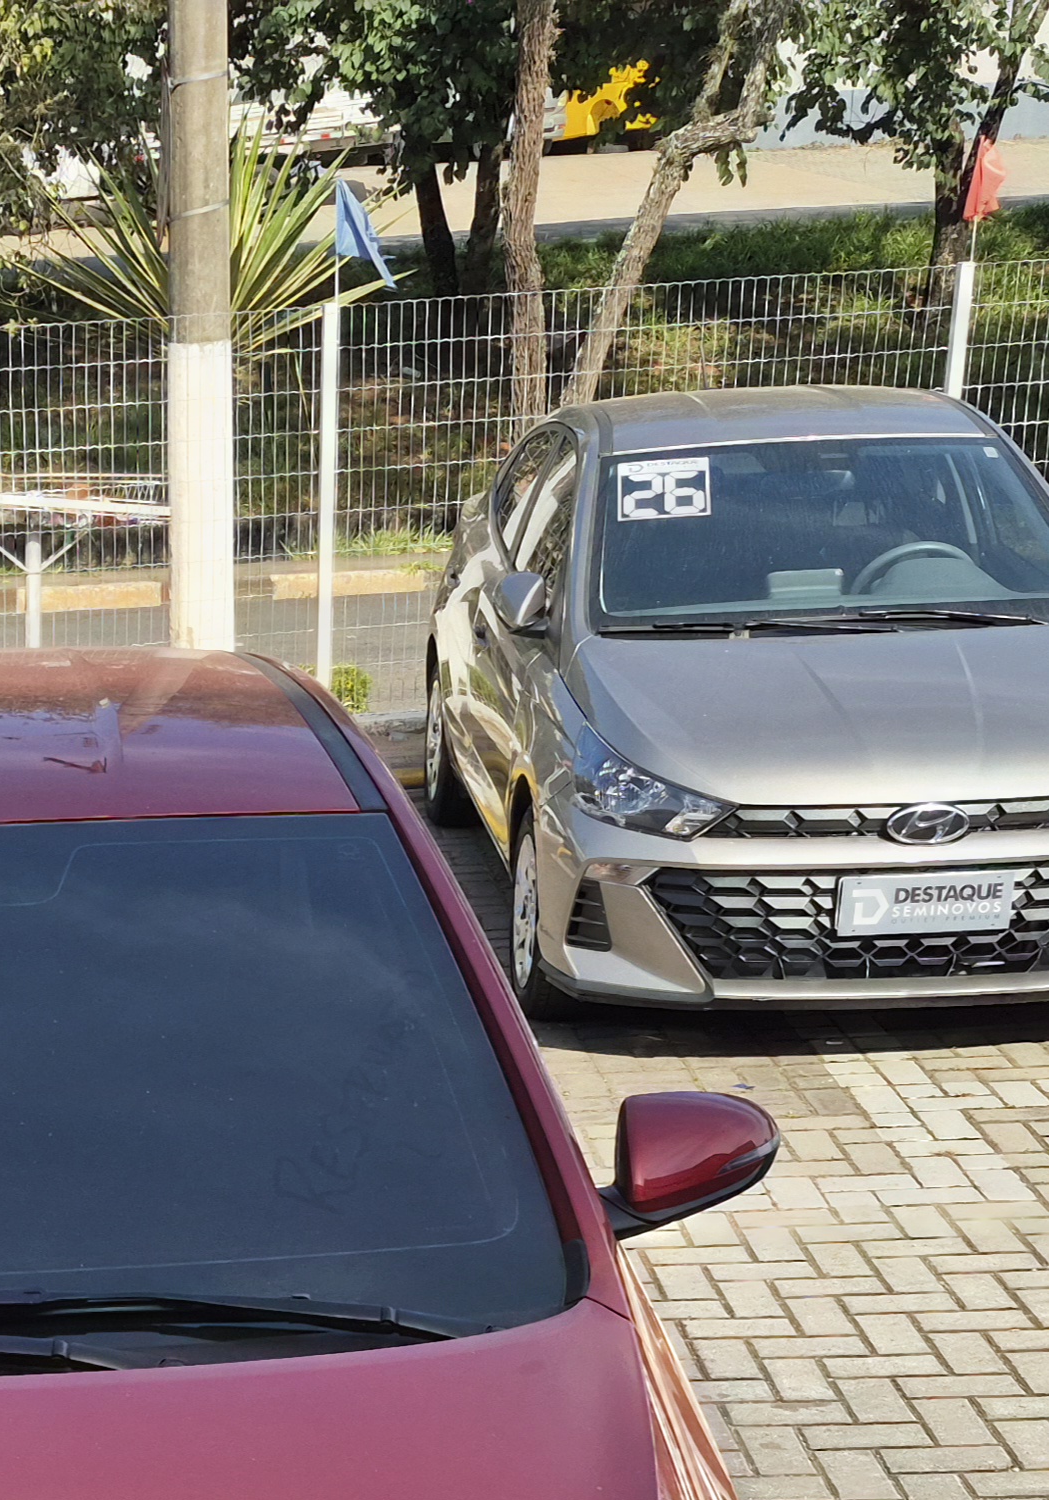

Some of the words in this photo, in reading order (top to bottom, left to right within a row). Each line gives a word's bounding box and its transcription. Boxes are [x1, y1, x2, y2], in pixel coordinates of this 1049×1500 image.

[623, 470, 706, 518] 26
[894, 882, 1005, 904] DESTAQUE
[891, 901, 1002, 918] SEMINOVOS
